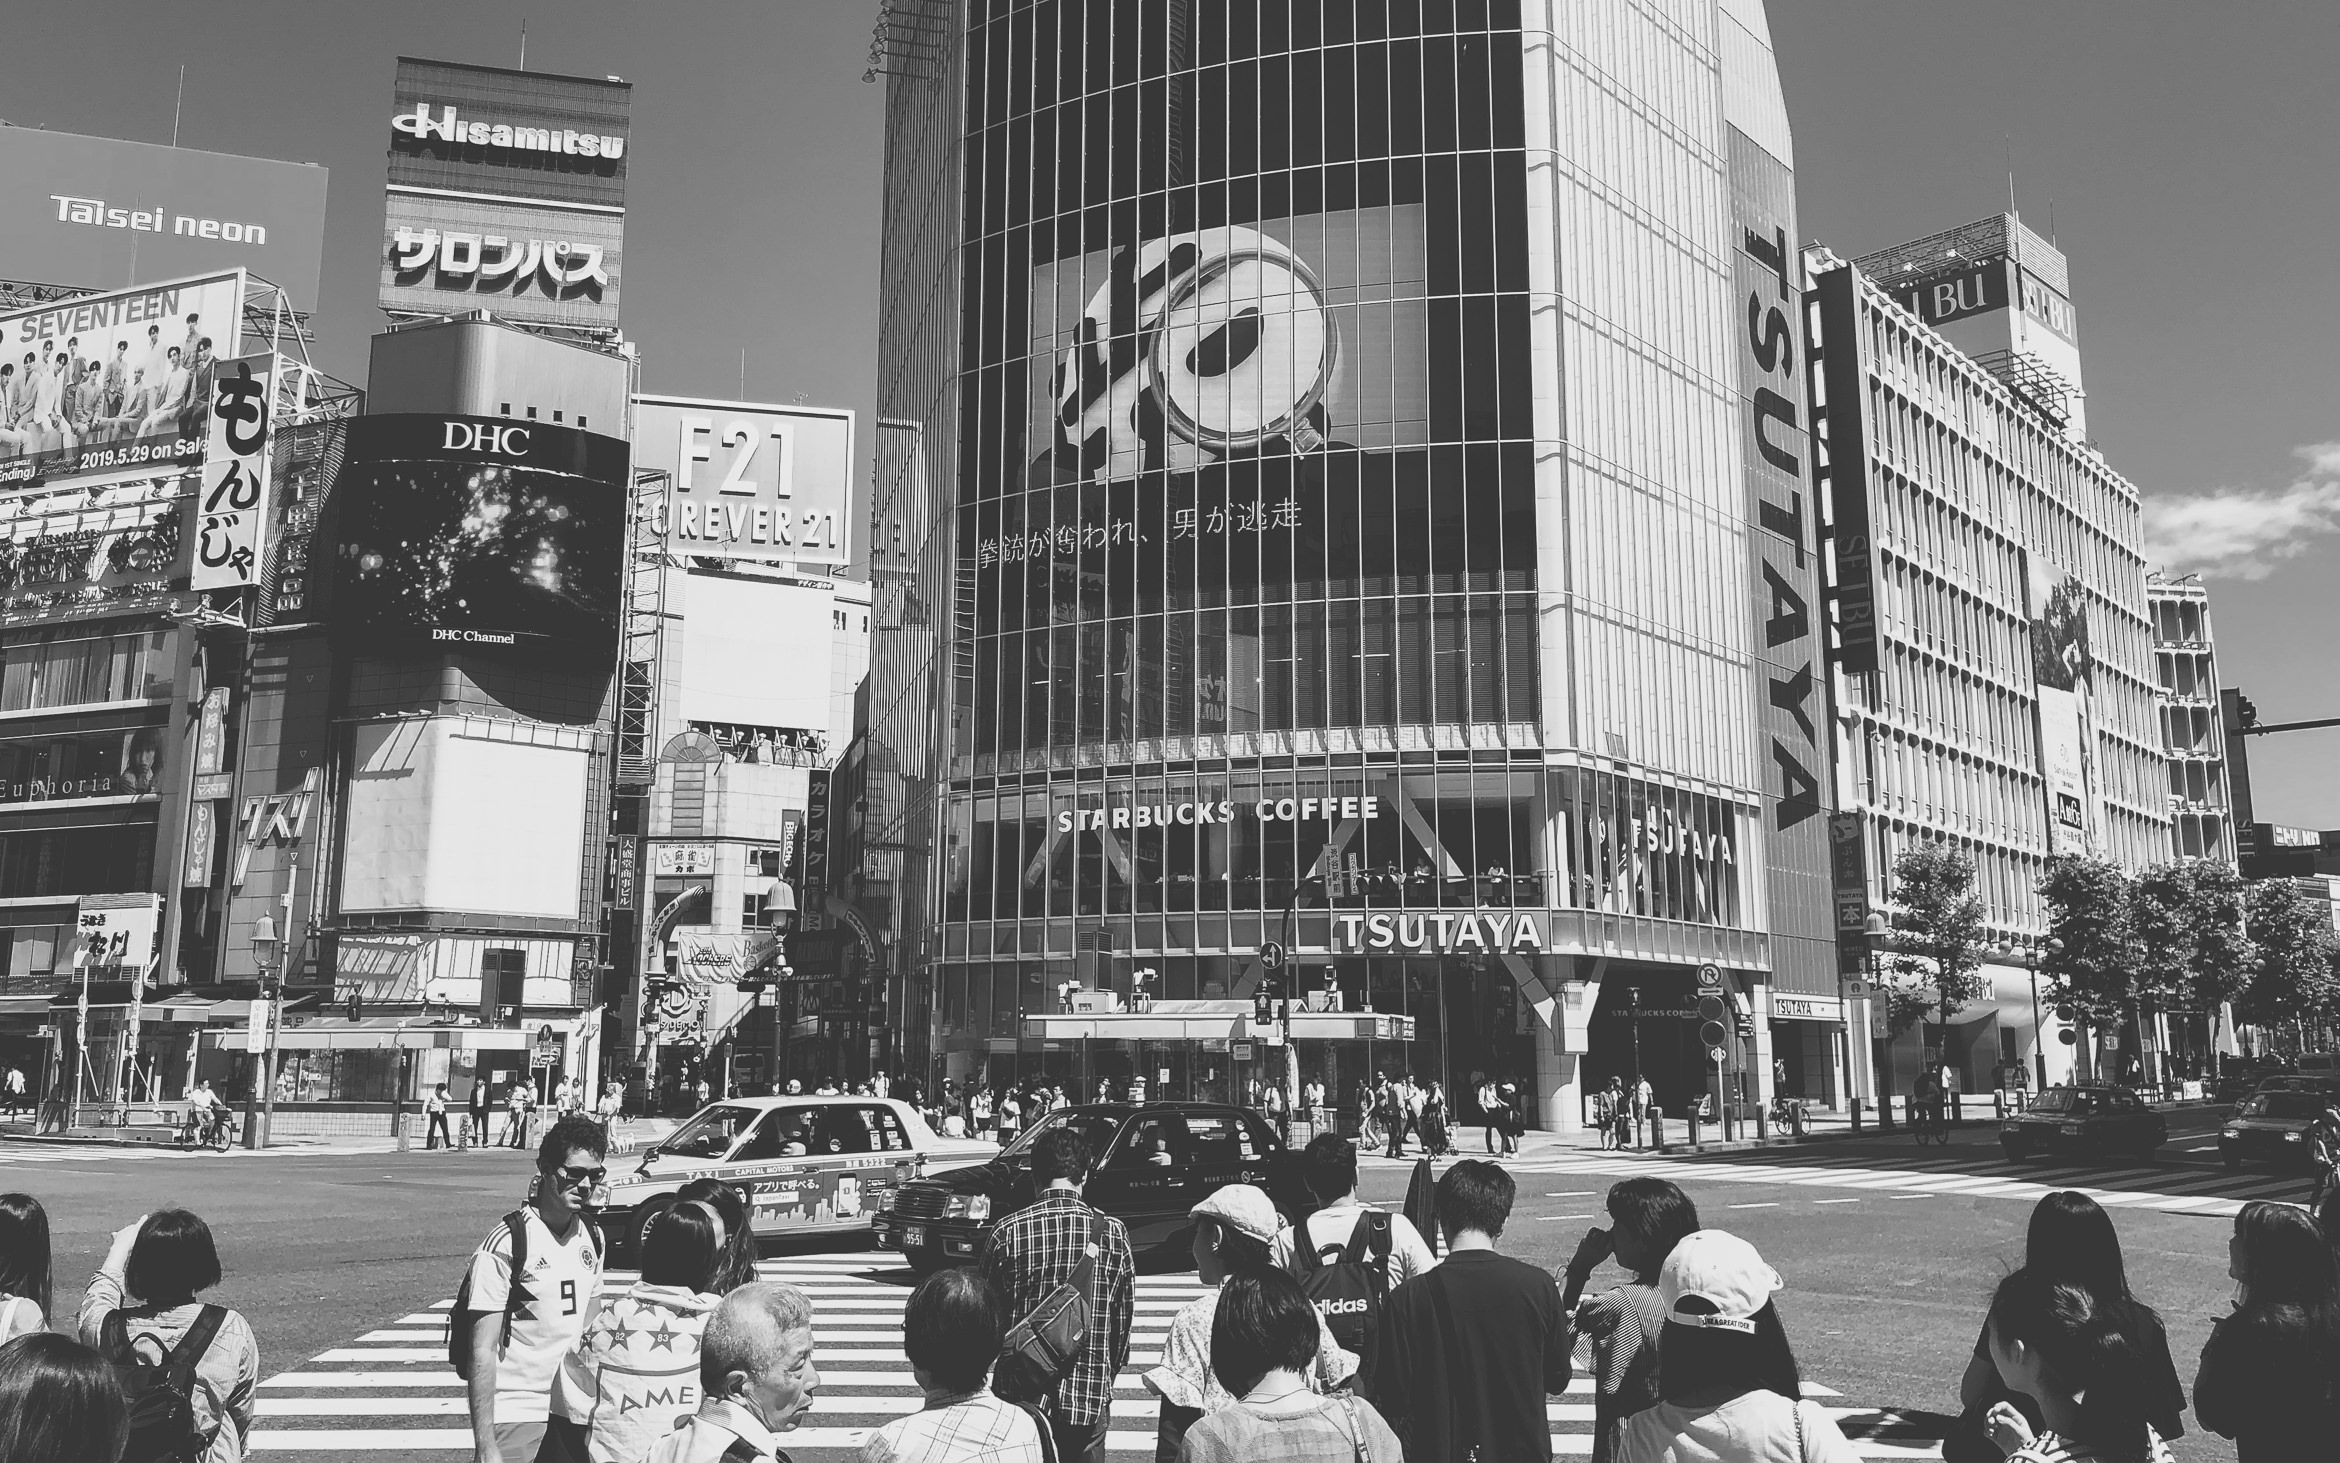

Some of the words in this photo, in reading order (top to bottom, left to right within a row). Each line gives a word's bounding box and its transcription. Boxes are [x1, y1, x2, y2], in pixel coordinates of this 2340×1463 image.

[392, 102, 624, 160] Hisamitsu
[49, 193, 165, 235] Taisei
[175, 214, 267, 246] neon
[393, 225, 608, 286] サロンパス
[20, 290, 180, 343] SEVENTEEN
[1913, 274, 1987, 323] IBU
[80, 445, 149, 469] 2019.5.29
[151, 446, 171, 458] on
[443, 421, 531, 456] DHC
[200, 362, 269, 583] もんじゃ
[677, 416, 795, 499] F21
[802, 508, 838, 548] 21
[1174, 497, 1302, 540] 男が逃走
[1744, 226, 1819, 832] TSUTAYA
[1838, 535, 1874, 646] SEIBU
[431, 628, 461, 643] DHC
[464, 630, 515, 645] Channel
[0, 774, 110, 802] Euphoria
[232, 766, 319, 886] クスリ
[808, 781, 827, 866] カラオケ
[1057, 800, 1235, 833] STARBUCKS
[1256, 796, 1379, 822] COFFEE
[620, 839, 634, 905] 大盛堂商事ビル
[80, 913, 106, 927] うなぎ
[1339, 914, 1542, 947] TSUTAYA
[1842, 905, 1861, 924] 本
[744, 938, 777, 957] Basketb
[1776, 999, 1811, 1015] TSUTAYA
[687, 1170, 719, 1180] TAXI
[735, 1167, 764, 1176] CAPITAL
[767, 1165, 794, 1174] MOTORS
[862, 1158, 887, 1168] 5322
[753, 1179, 820, 1193] アプリで呼べる。
[560, 1279, 577, 1316] 9
[615, 1332, 626, 1341] 82
[657, 1334, 669, 1342] 83
[620, 1386, 695, 1415] AME
